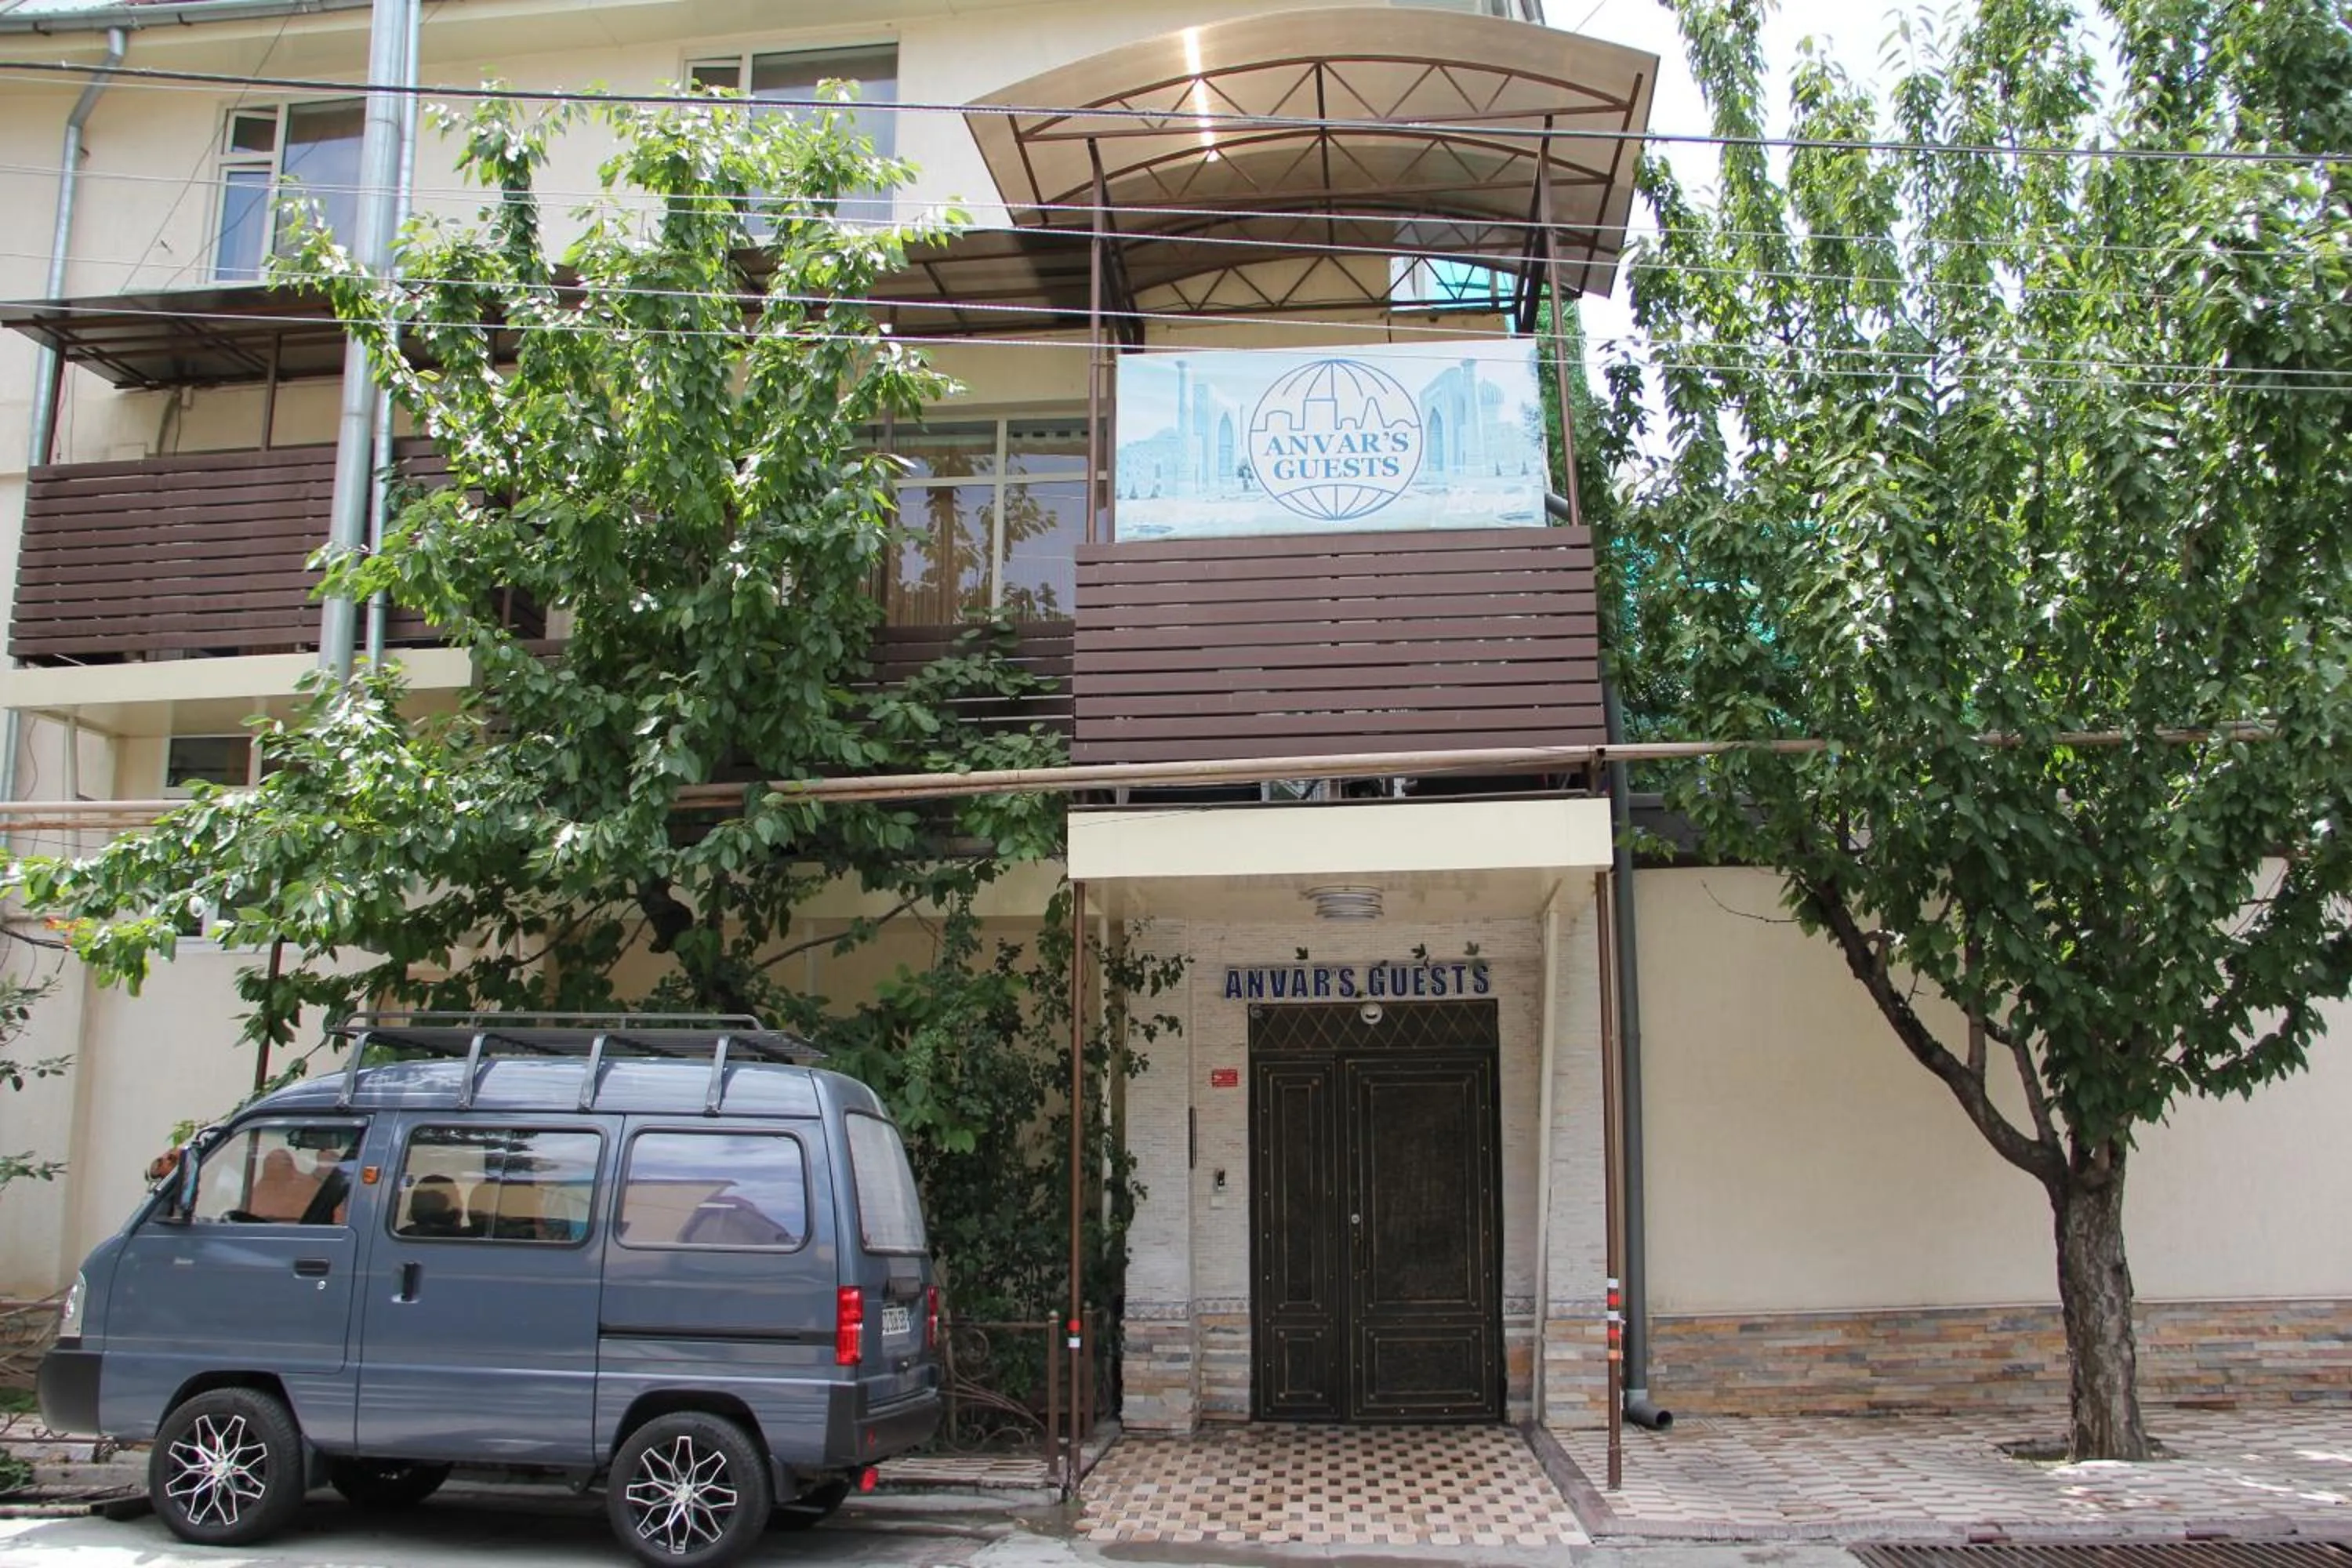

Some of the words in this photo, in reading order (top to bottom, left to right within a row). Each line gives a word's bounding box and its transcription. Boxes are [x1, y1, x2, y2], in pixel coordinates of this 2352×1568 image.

[1264, 431, 1410, 456] ANVAR'S
[1273, 456, 1400, 481] GUESTS
[1225, 967, 1356, 1000] ANVAR'S
[1367, 964, 1490, 997] GUESTS
